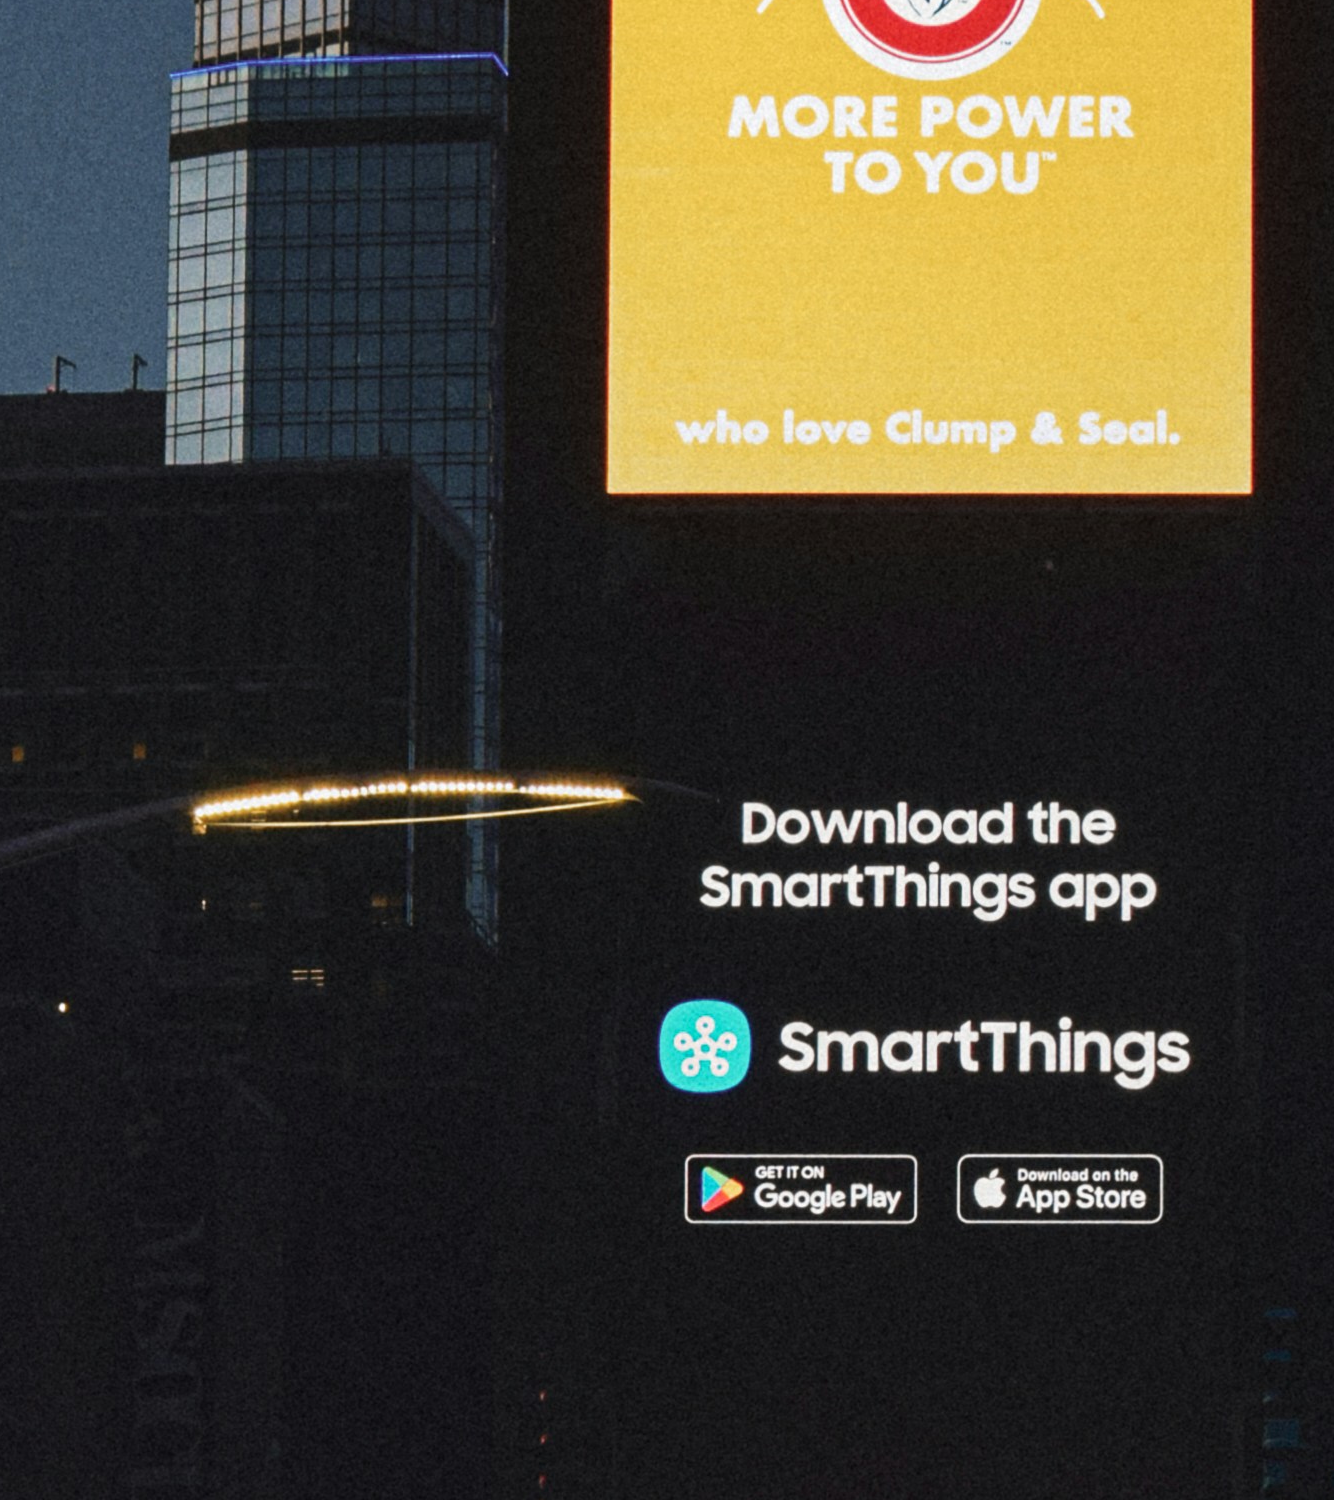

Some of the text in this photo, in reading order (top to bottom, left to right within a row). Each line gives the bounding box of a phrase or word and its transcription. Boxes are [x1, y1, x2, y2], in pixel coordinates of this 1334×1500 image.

[727, 95, 1134, 139] MORE POWER
[824, 150, 902, 194] TO
[675, 409, 1180, 452] who love Clump & Seal.
[742, 802, 1116, 845] Download the
[700, 862, 1156, 921] SmartThings app
[778, 1016, 1190, 1090] SmartThings
[755, 1166, 824, 1179] GET IT ON
[1017, 1168, 1138, 1182] Download on the
[755, 1184, 901, 1214] Google Play
[1016, 1185, 1146, 1214] App Store
